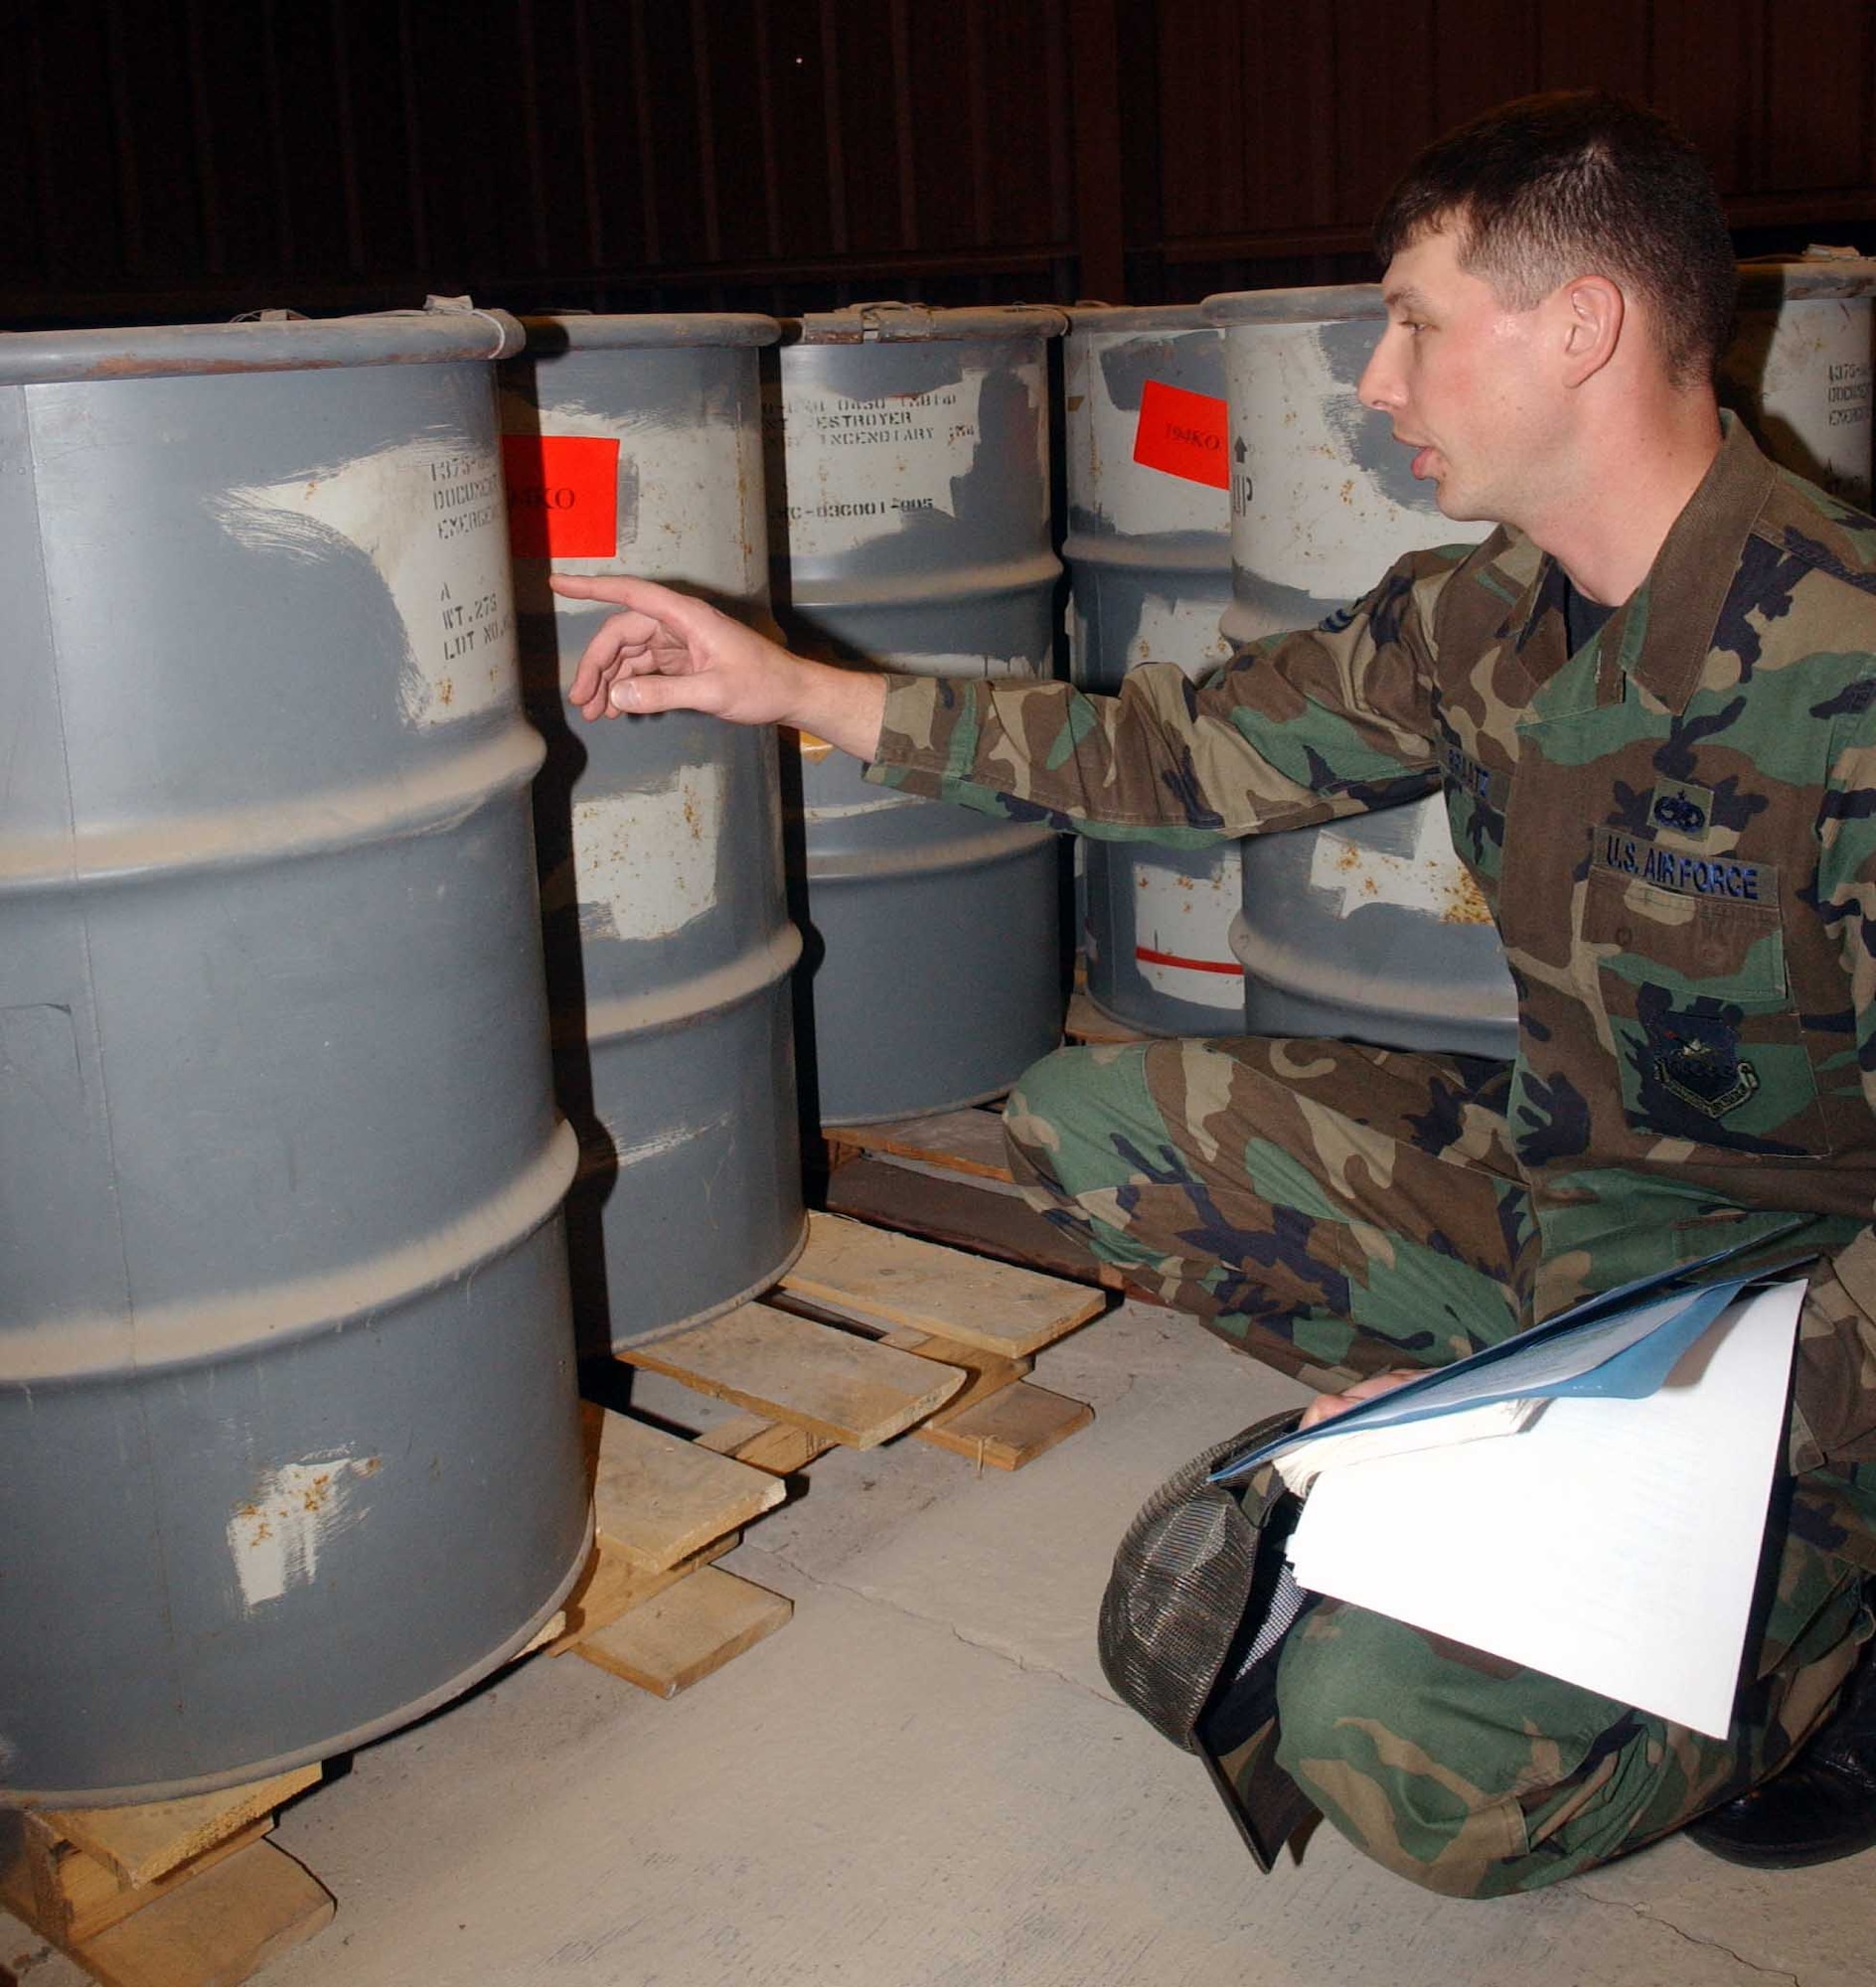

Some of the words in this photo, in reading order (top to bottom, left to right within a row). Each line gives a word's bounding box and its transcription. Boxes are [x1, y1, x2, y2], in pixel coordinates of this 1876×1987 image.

[807, 410, 912, 430] ESTROYER
[1232, 474, 1253, 518] UP
[440, 581, 451, 602] A
[443, 630, 475, 661] LOT
[1606, 834, 1640, 874] U.S.
[1643, 846, 1675, 885] AIR
[1679, 857, 1760, 901] FORCE
